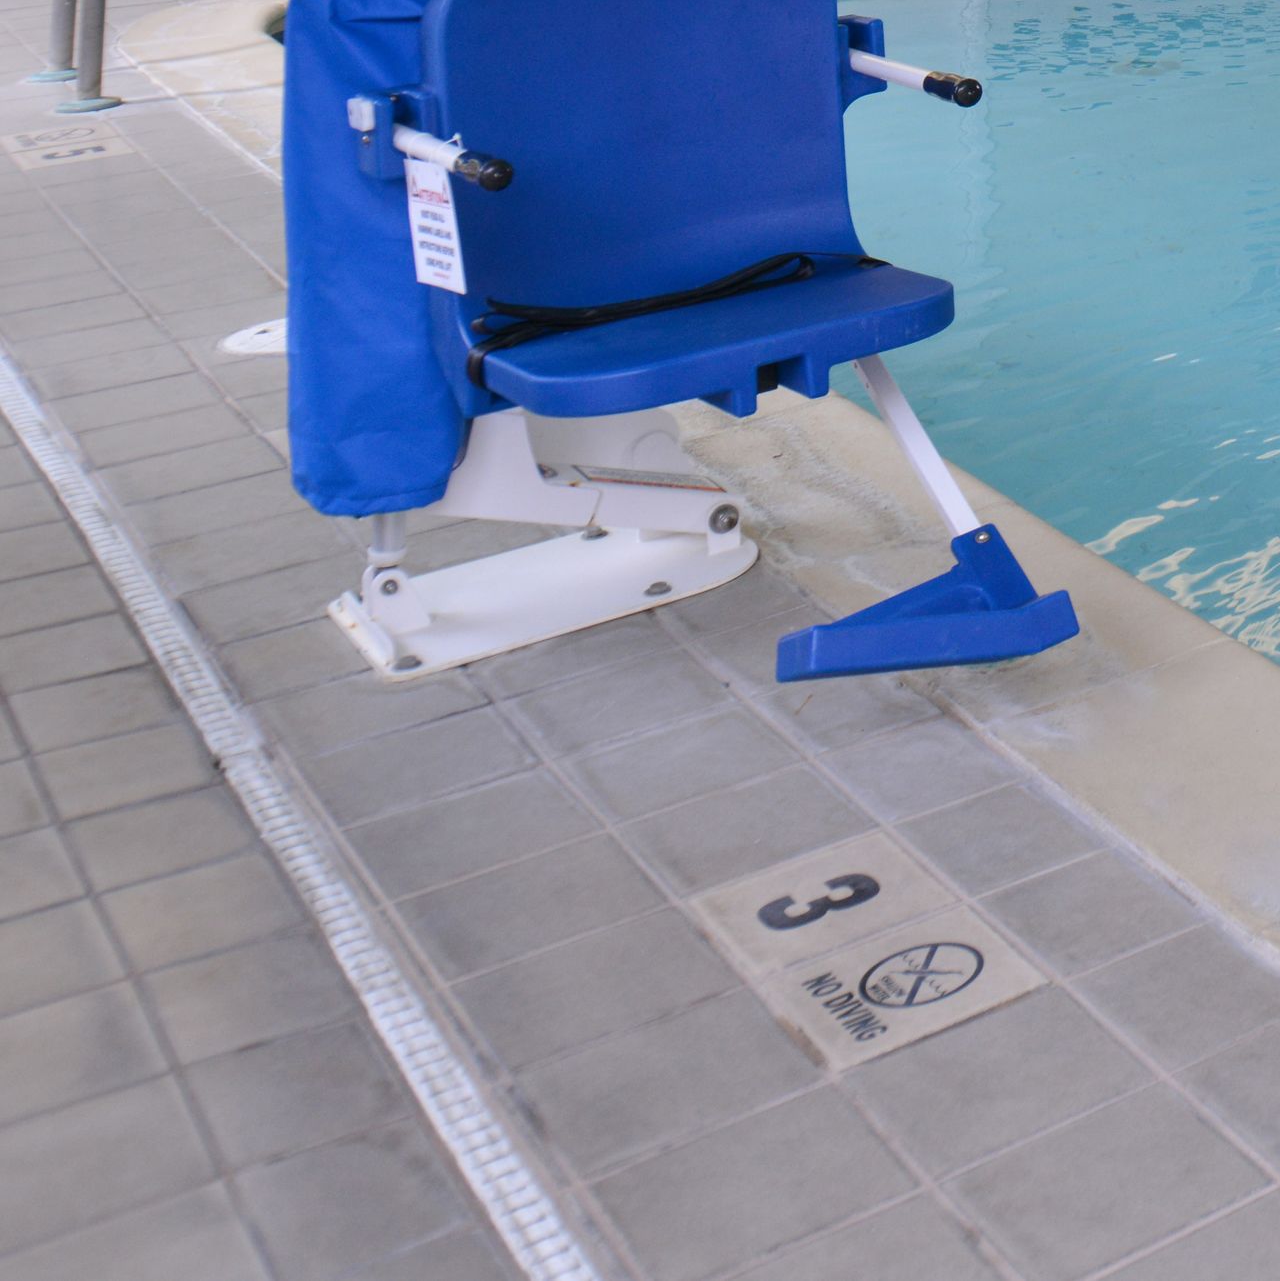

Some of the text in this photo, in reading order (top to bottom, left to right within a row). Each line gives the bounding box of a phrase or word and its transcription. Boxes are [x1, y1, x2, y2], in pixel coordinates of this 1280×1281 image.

[756, 872, 881, 931] 3
[801, 970, 888, 1043] NO DIVING
